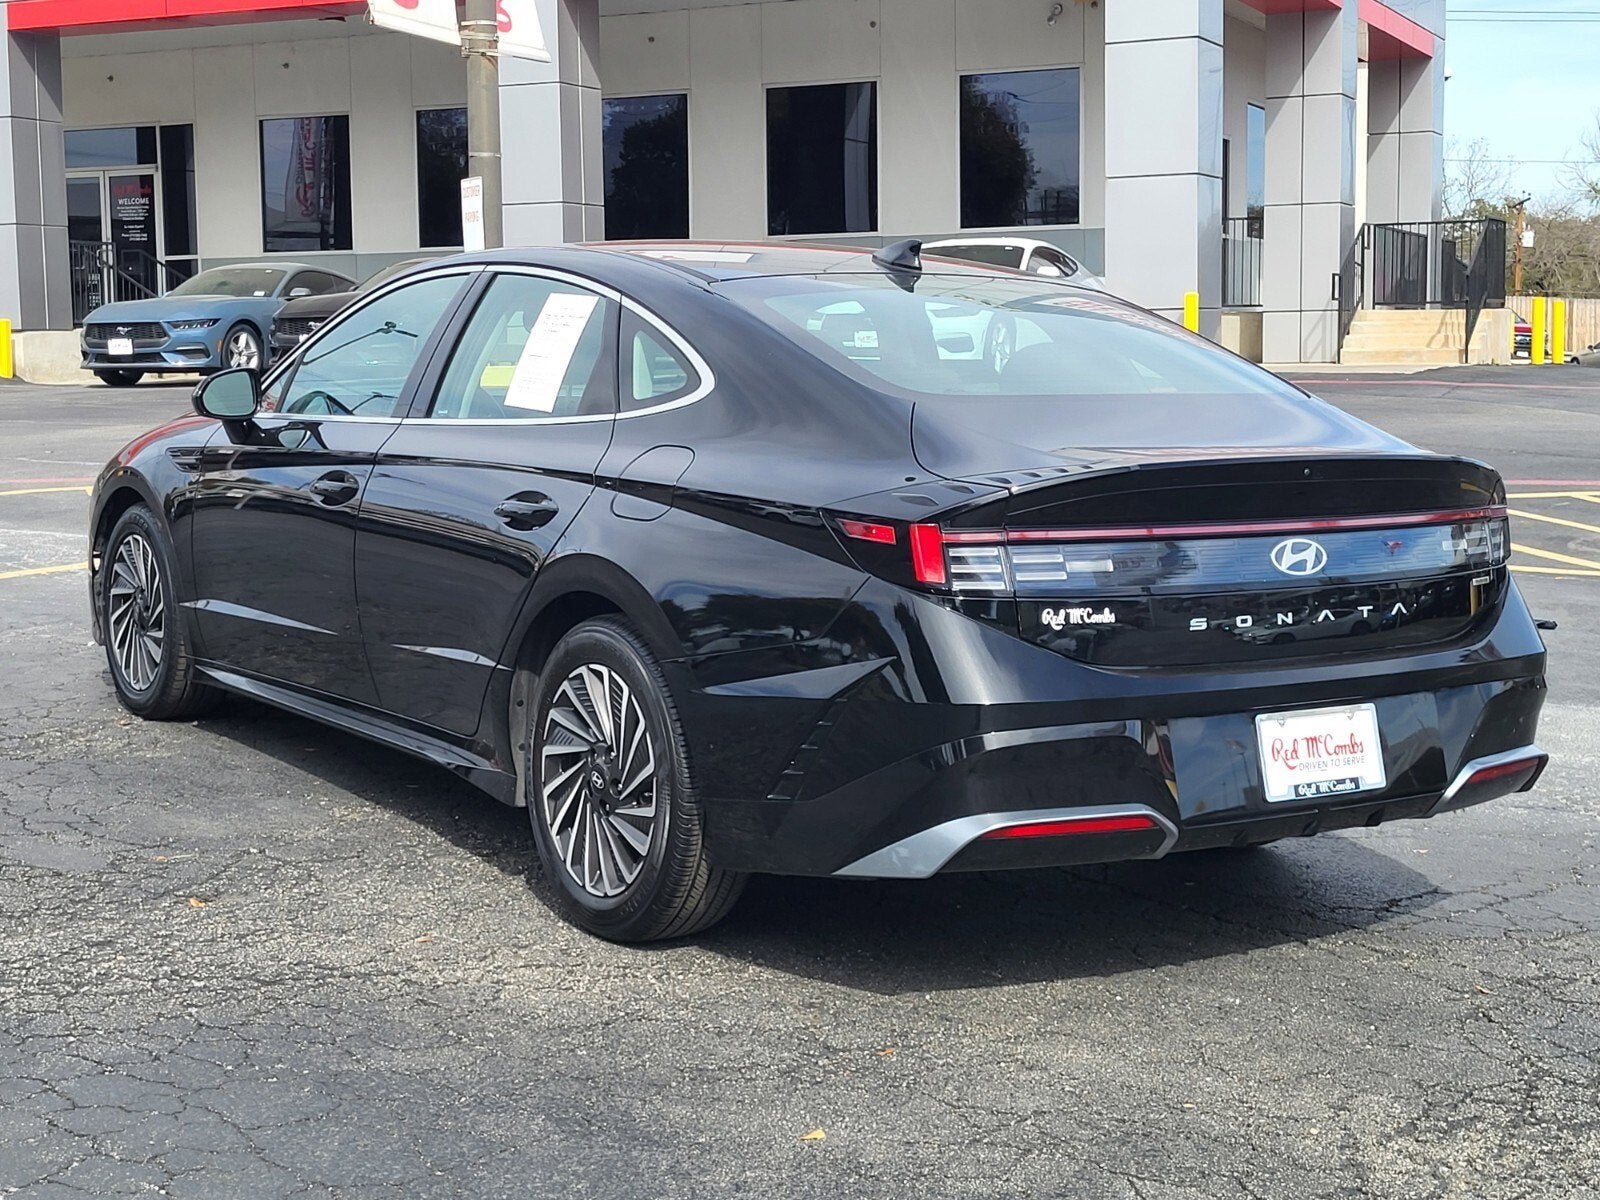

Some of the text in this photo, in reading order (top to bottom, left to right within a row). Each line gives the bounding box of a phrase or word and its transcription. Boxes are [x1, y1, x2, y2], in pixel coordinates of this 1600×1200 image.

[118, 197, 149, 205] WELCOME
[1041, 607, 1116, 631] Red McCombs
[1189, 602, 1408, 631] SONATA
[1271, 732, 1364, 771] Red McCombs
[1299, 755, 1365, 772] DRIVEN TO SERVE
